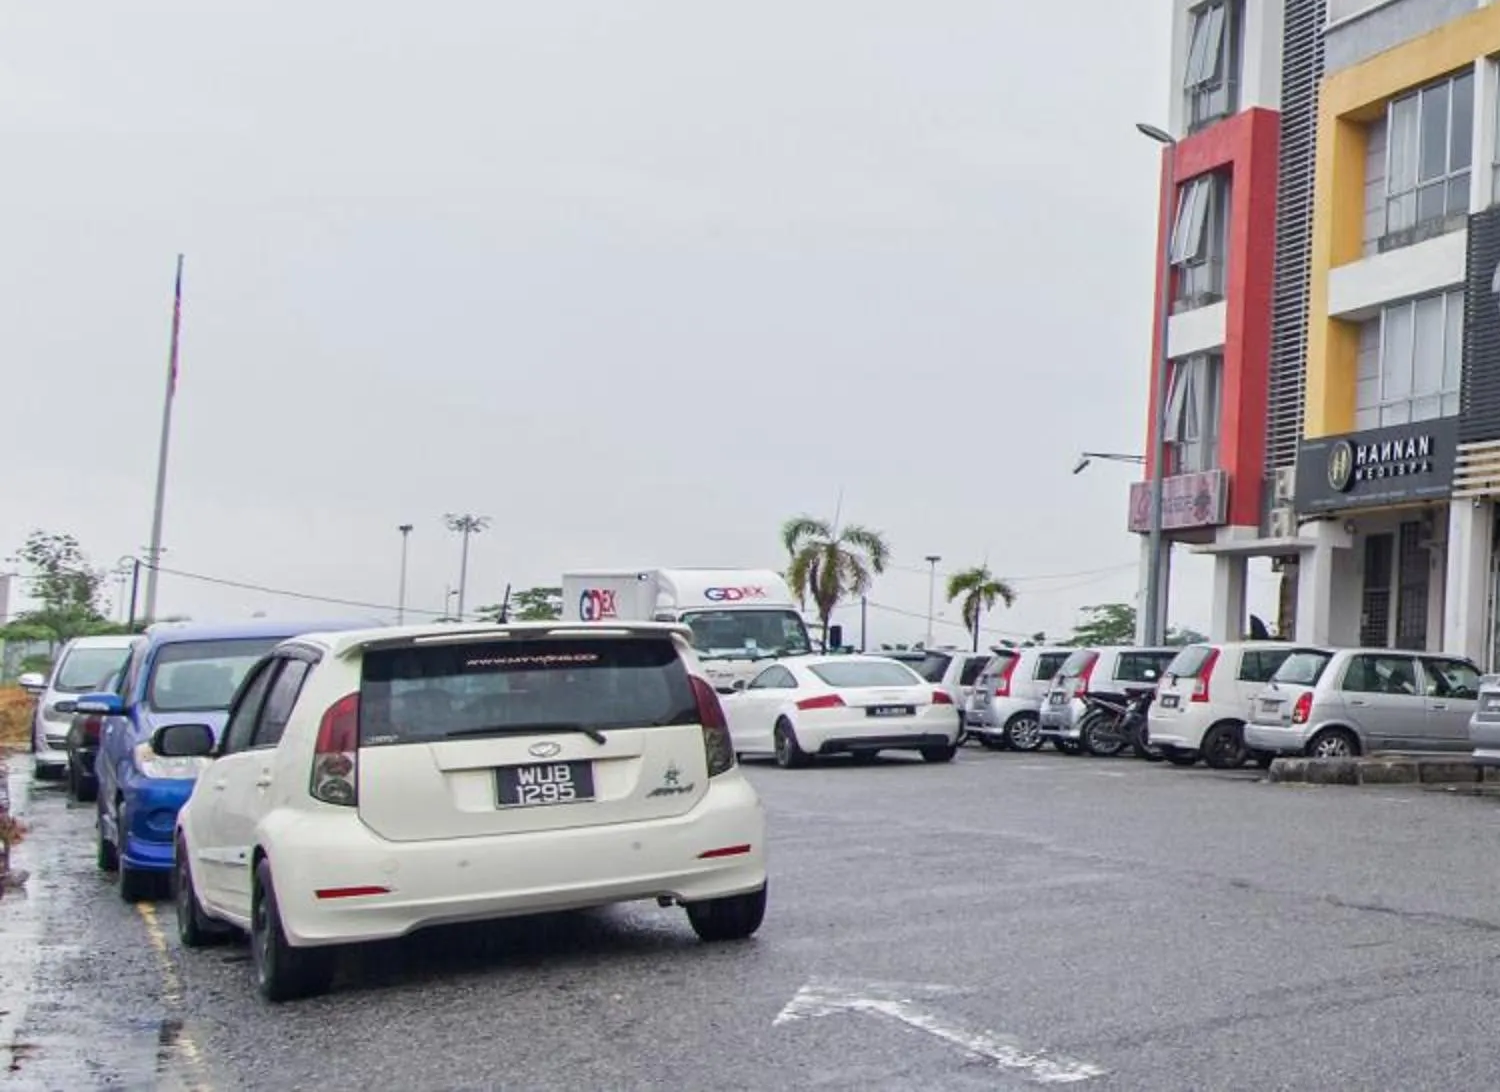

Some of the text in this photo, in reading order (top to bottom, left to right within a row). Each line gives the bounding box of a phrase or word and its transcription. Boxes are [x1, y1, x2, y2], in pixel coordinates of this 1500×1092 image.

[1357, 435, 1430, 465] HANNAN
[517, 764, 572, 785] WUB
[515, 783, 576, 805] 1295
